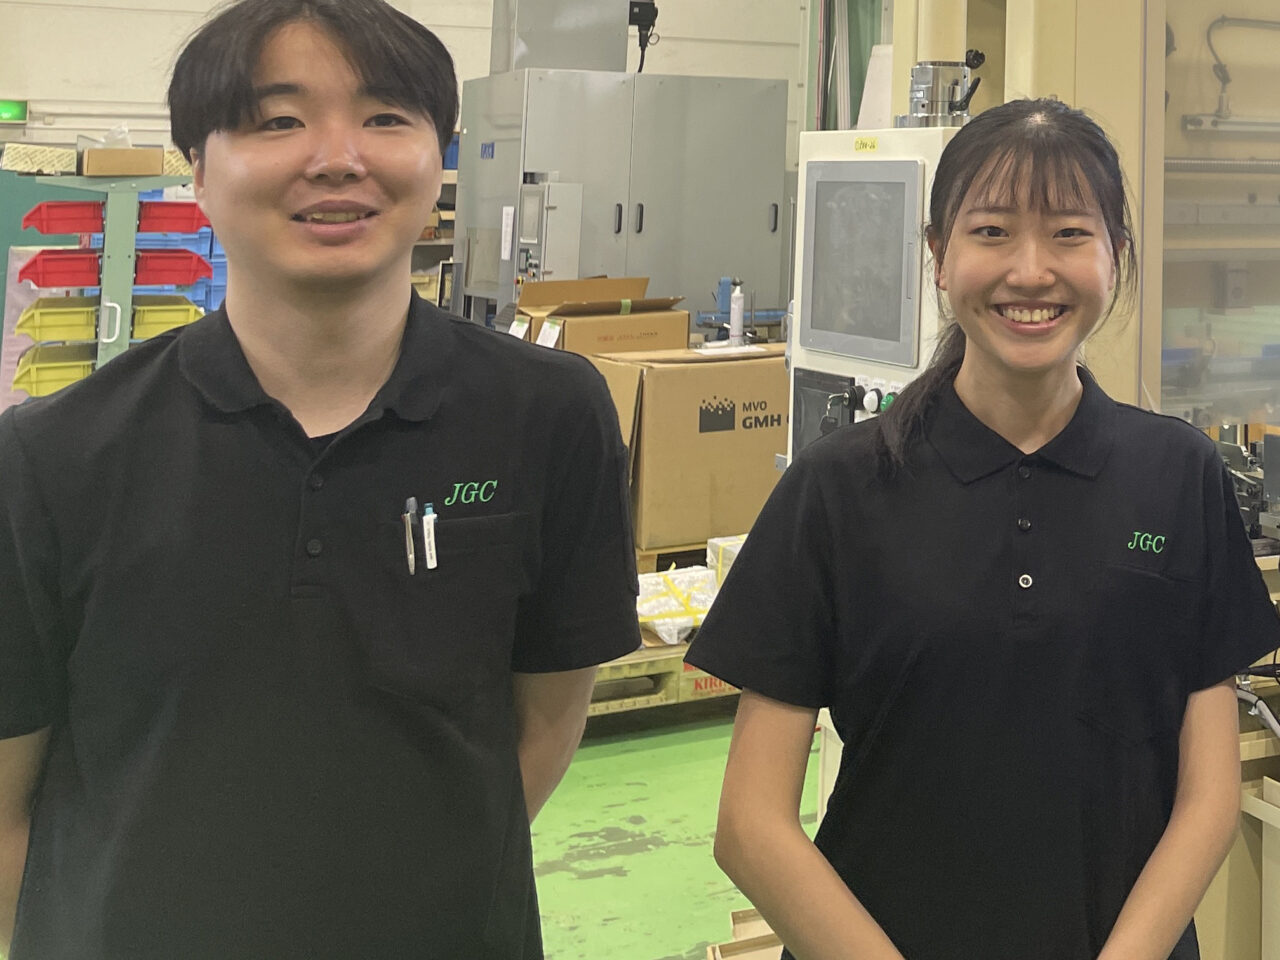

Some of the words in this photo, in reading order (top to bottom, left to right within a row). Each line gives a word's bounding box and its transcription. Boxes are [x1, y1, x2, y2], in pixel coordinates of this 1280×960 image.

[742, 400, 768, 412] MVO
[742, 413, 782, 430] GMH
[444, 480, 498, 506] JGC
[1127, 531, 1166, 554] JGC
